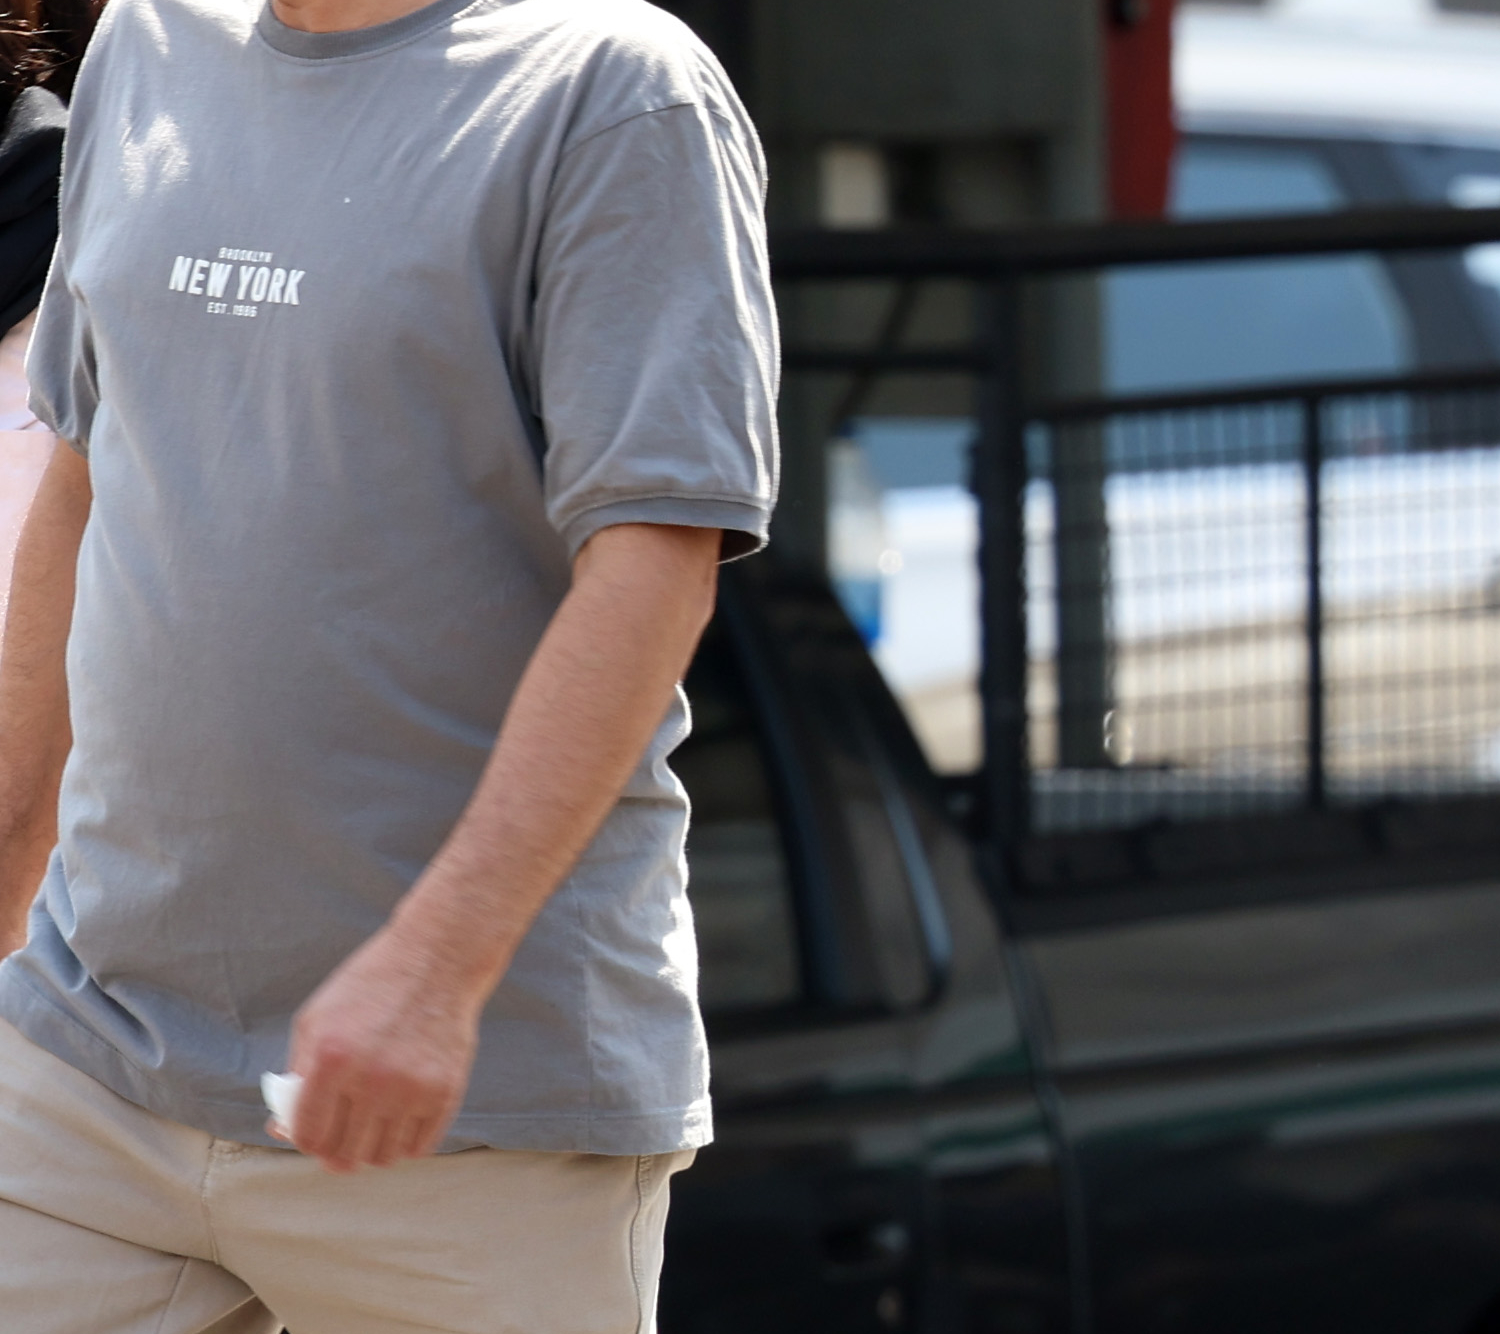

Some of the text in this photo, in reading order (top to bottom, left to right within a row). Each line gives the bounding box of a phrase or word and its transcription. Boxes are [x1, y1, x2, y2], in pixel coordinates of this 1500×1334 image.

[218, 247, 273, 262] BROOKLYN
[168, 255, 305, 305] NEW YORK
